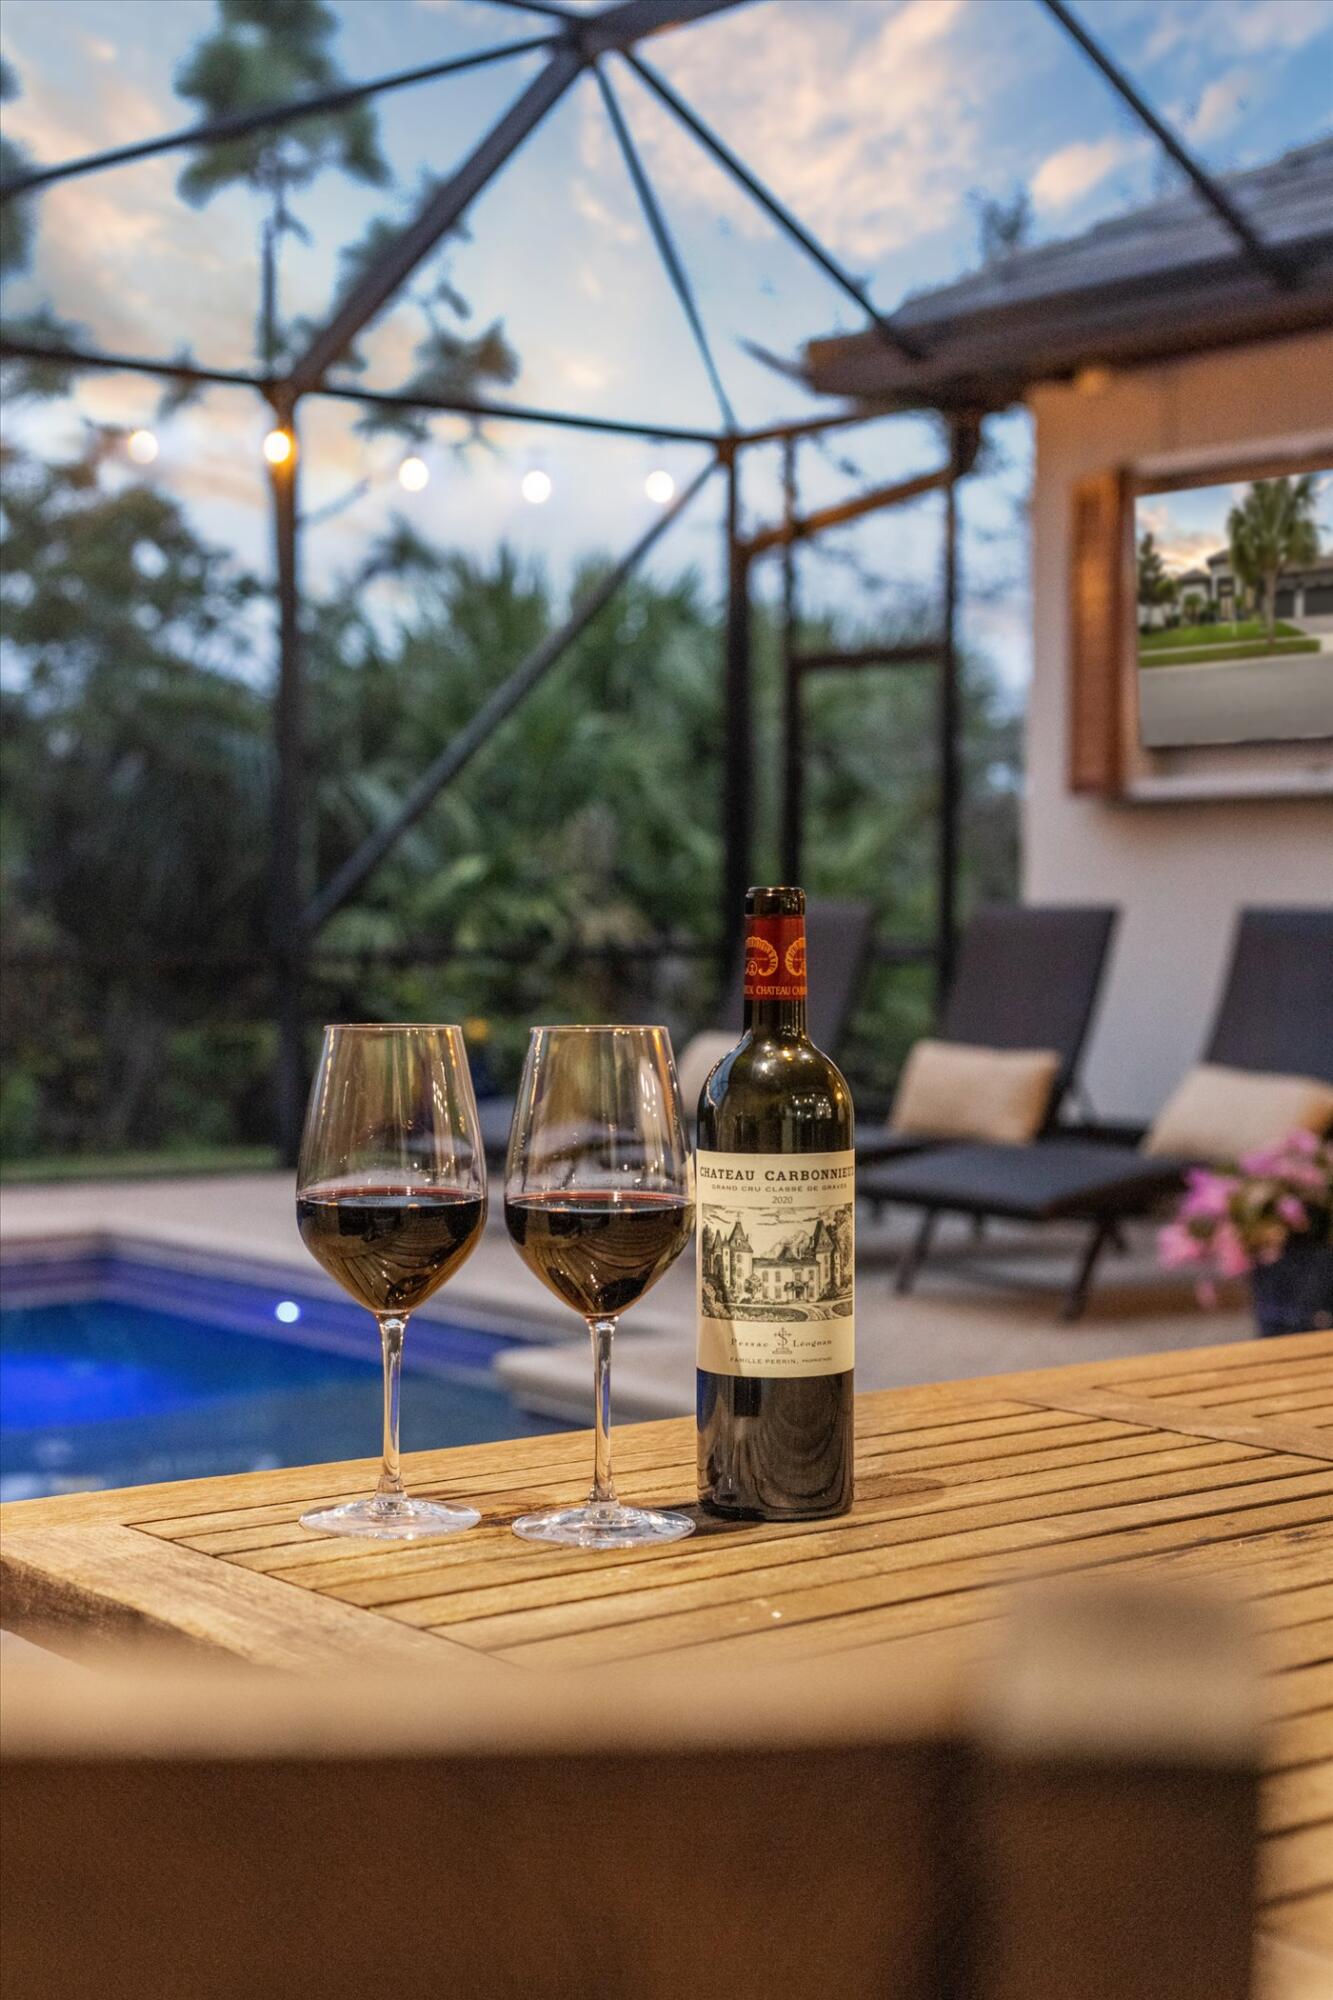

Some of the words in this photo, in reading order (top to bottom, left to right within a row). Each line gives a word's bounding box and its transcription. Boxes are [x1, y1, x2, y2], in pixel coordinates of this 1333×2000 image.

[756, 985, 791, 996] CHATEAU
[700, 1166, 755, 1181] CHATEAU
[711, 1184, 738, 1192] GRAND
[741, 1185, 761, 1193] CRU
[771, 1195, 793, 1205] 2020
